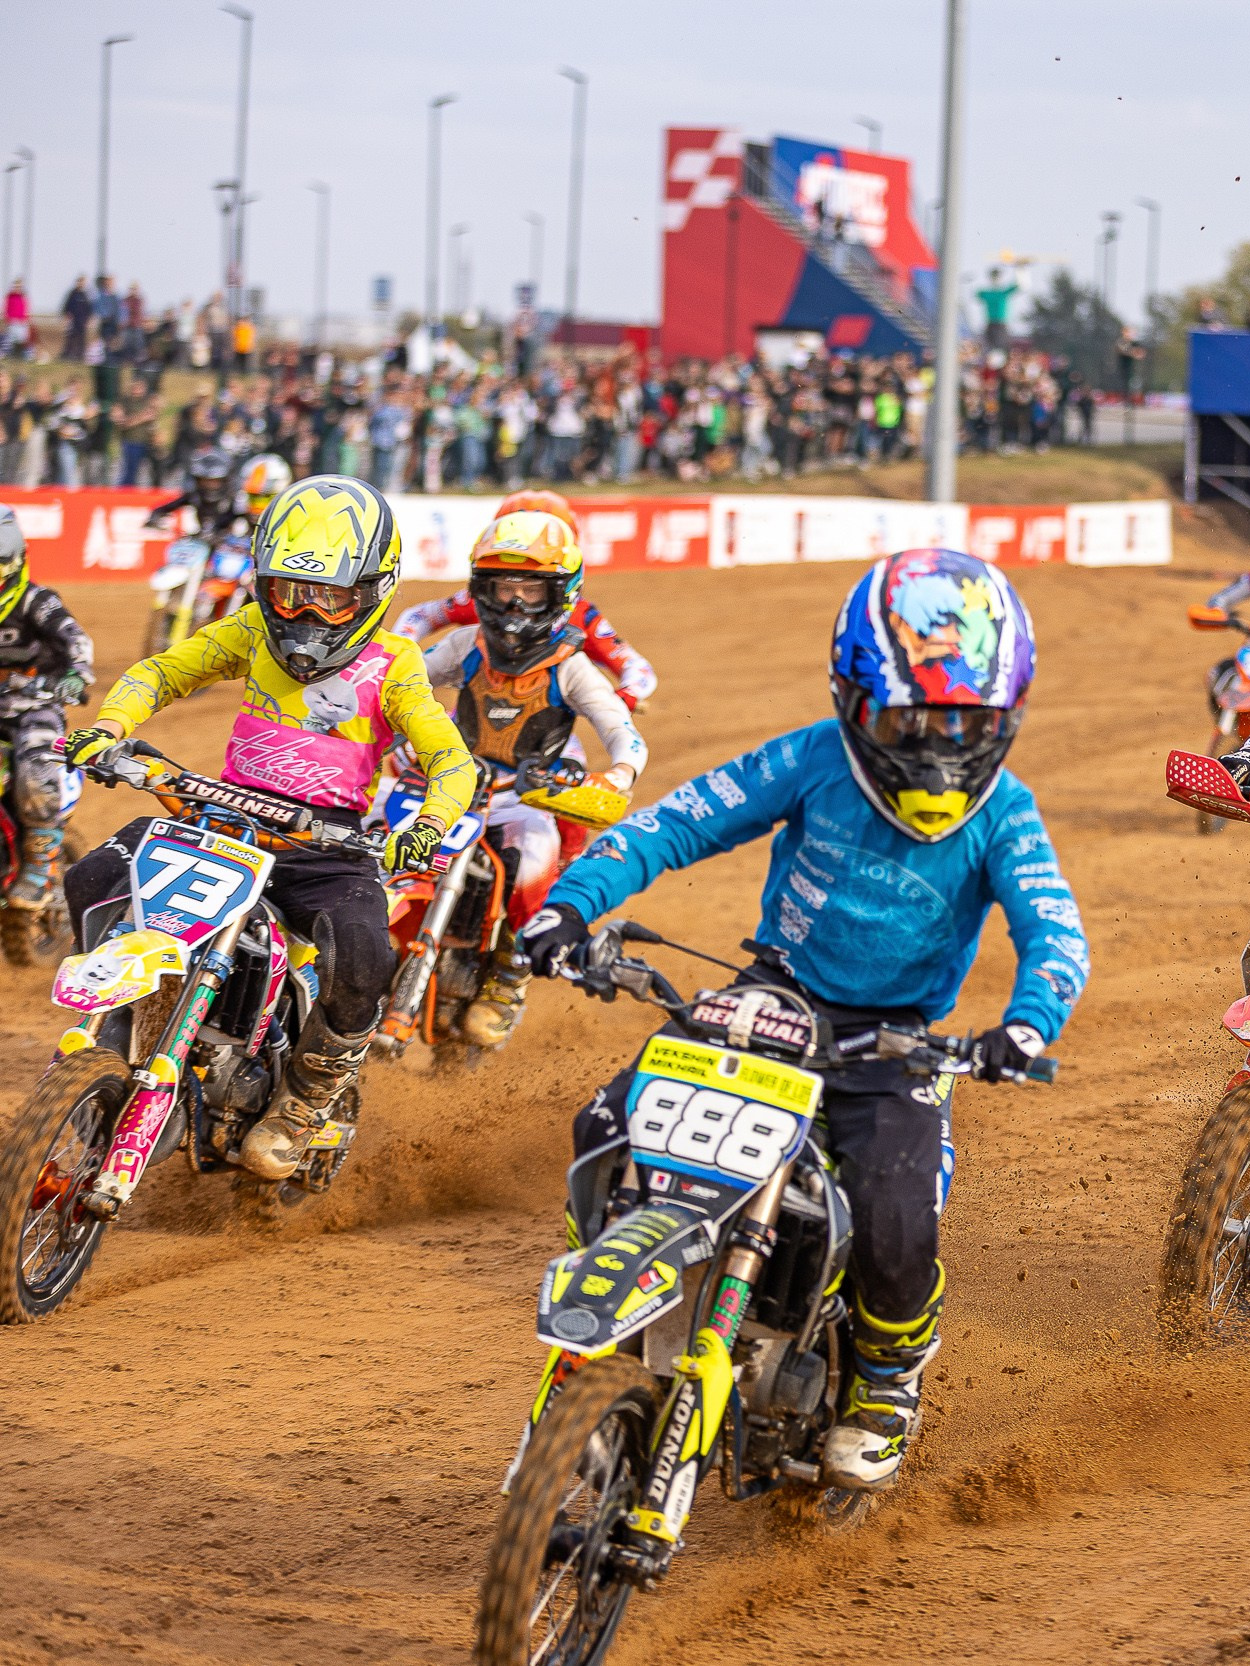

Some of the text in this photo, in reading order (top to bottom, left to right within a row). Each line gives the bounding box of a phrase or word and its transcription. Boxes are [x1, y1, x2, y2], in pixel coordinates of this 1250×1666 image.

[281, 551, 325, 573] 6D
[183, 778, 296, 823] RENTHAL
[139, 846, 246, 920] 73
[629, 1078, 799, 1180] 888
[648, 1381, 696, 1503] DUNLOP
